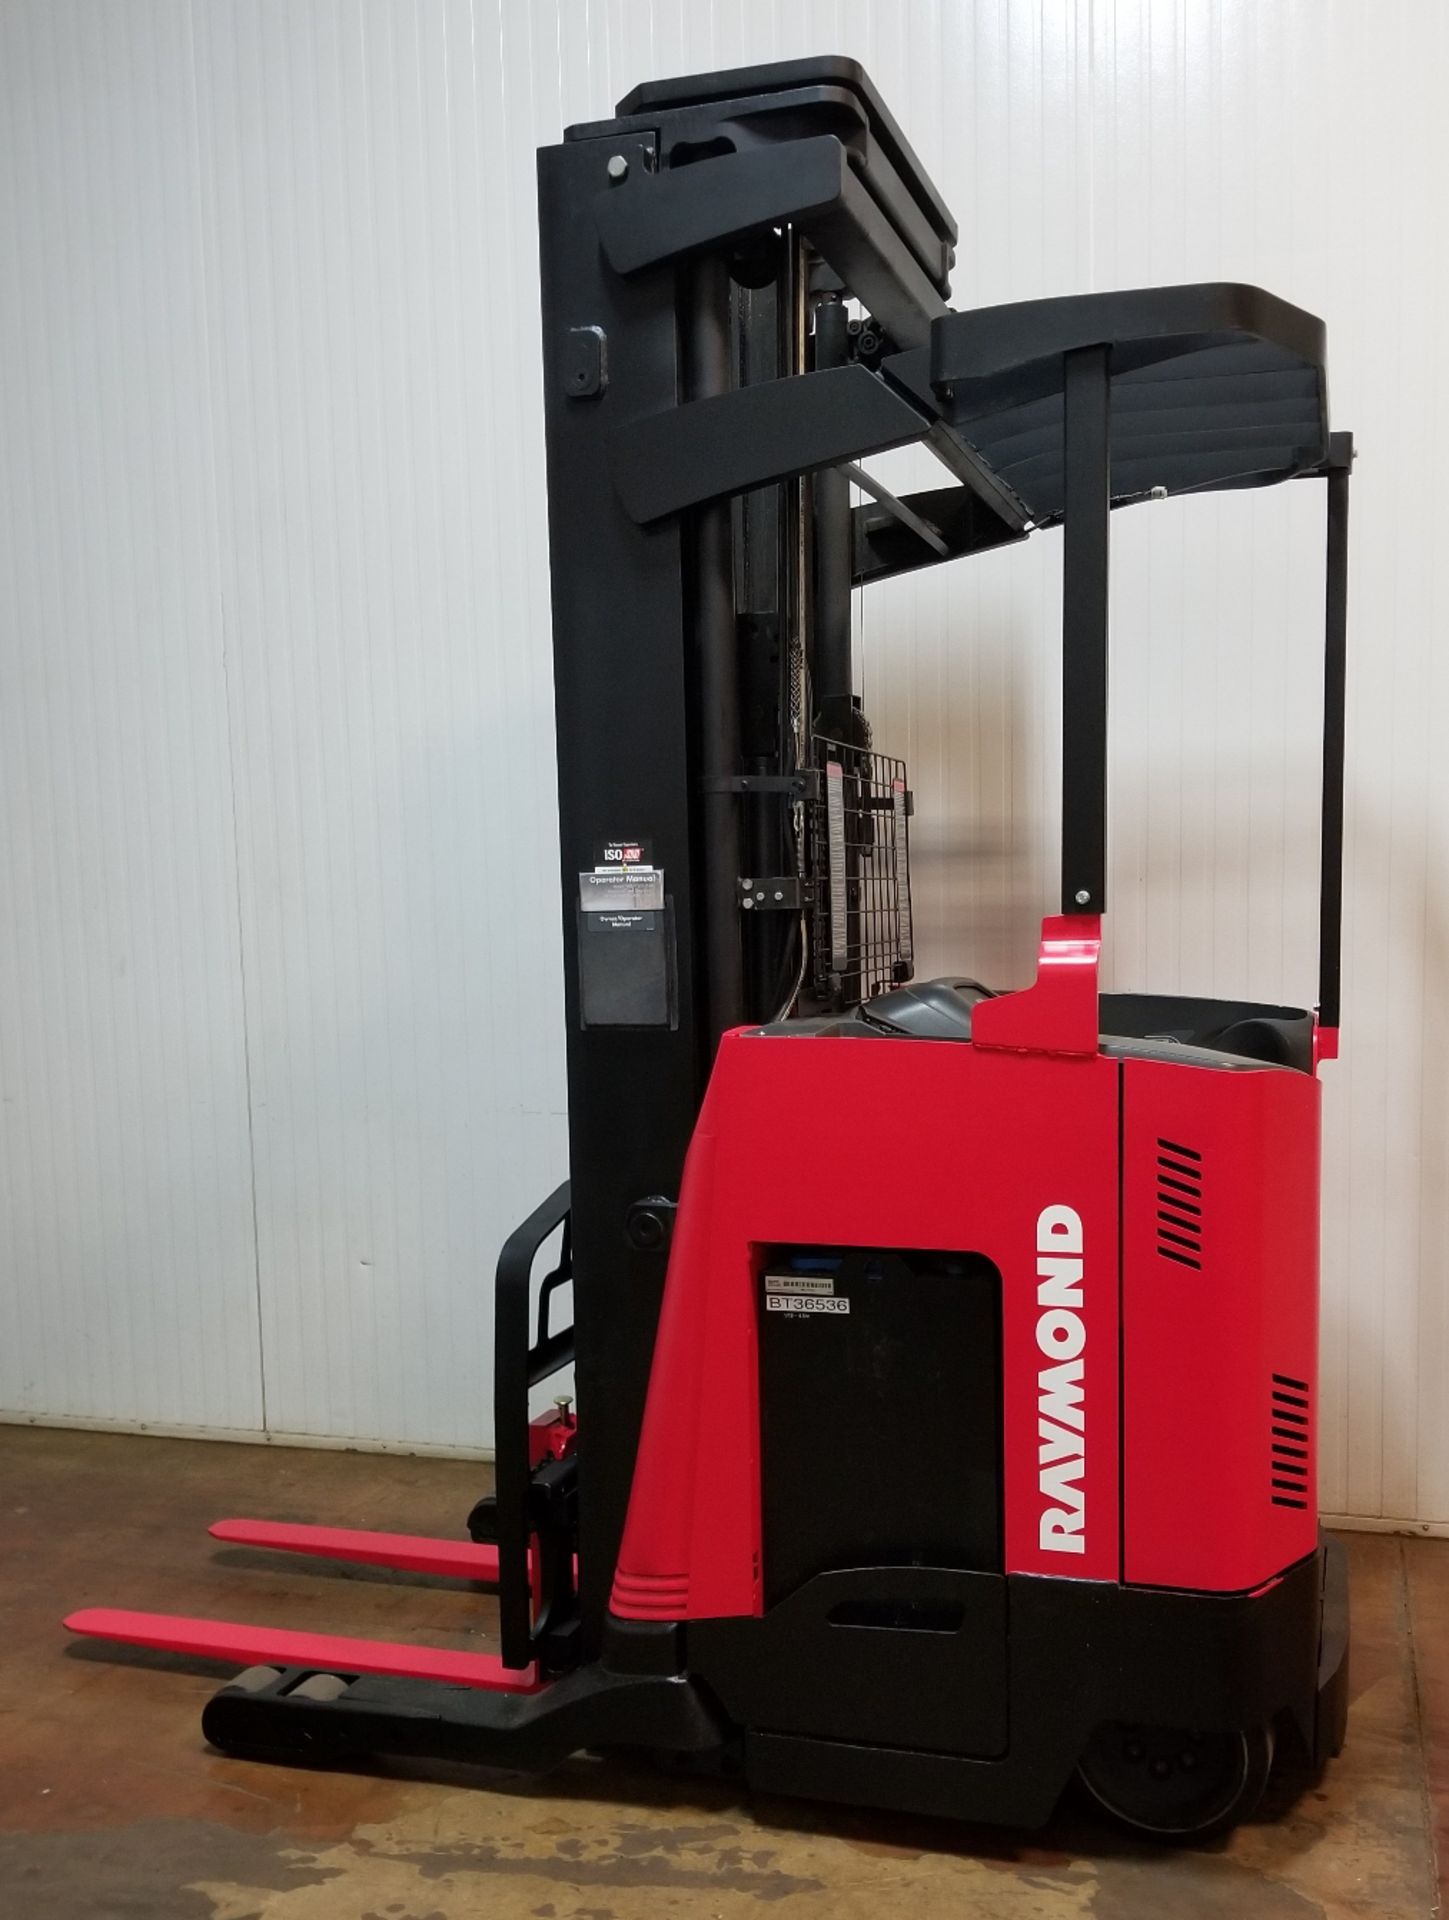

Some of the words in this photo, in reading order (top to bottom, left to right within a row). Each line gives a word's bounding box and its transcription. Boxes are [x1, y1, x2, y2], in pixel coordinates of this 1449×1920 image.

[589, 876, 624, 886] Operator
[626, 874, 656, 882] Manual
[769, 1297, 847, 1311] BT36536
[1036, 1205, 1087, 1554] RAYMOND
